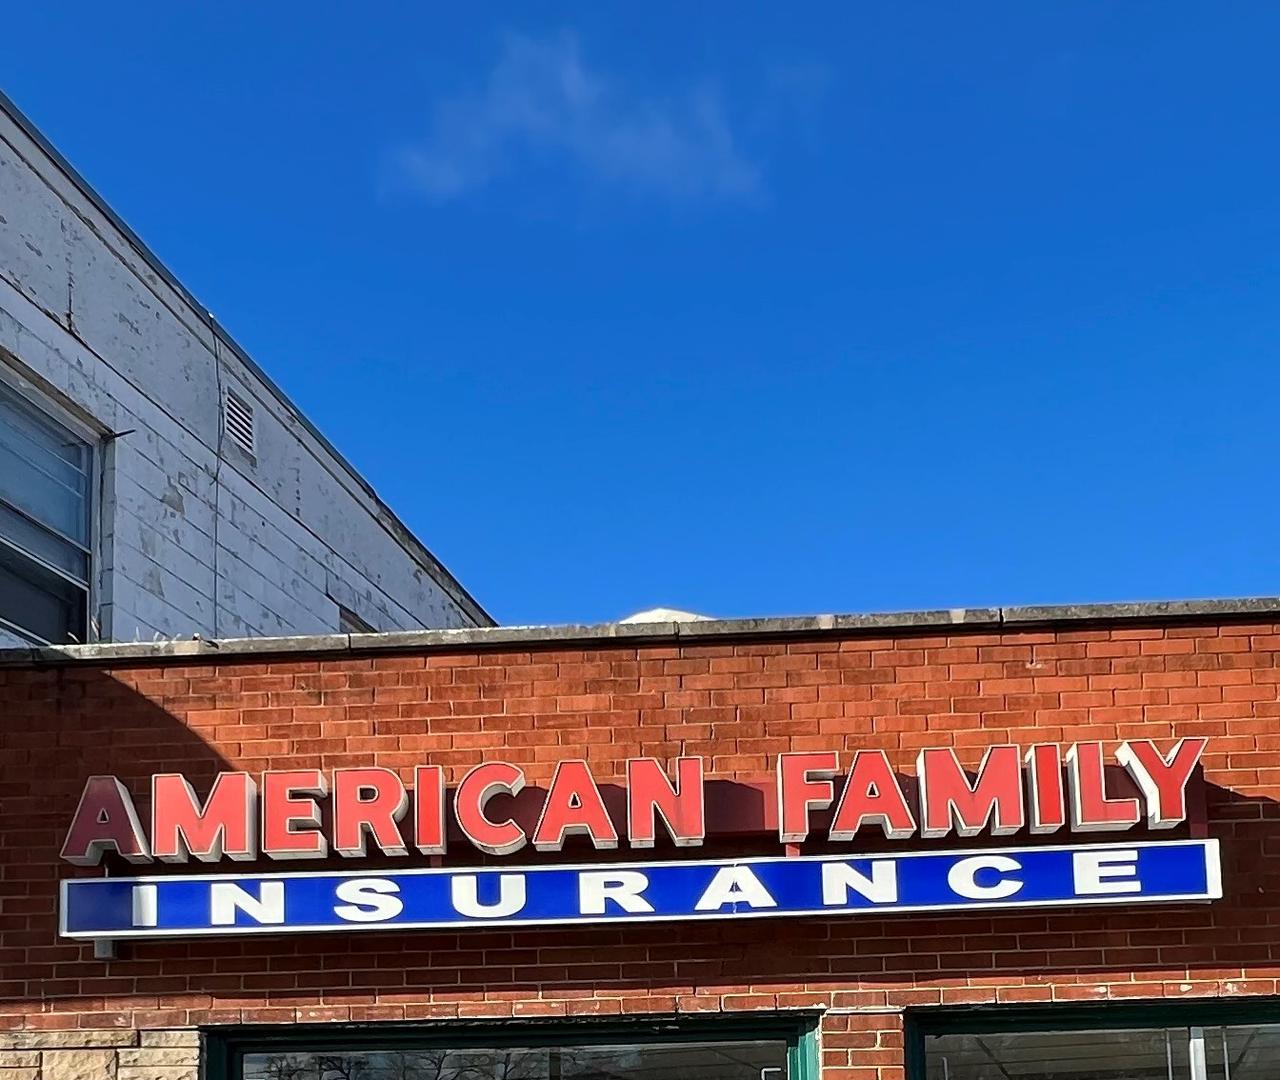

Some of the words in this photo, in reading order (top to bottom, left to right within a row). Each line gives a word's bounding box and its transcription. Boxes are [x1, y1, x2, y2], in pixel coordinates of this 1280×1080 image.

[60, 755, 705, 864] AMERICAN
[777, 736, 1208, 843] FAMILY
[131, 850, 1142, 927] INSURANCE
